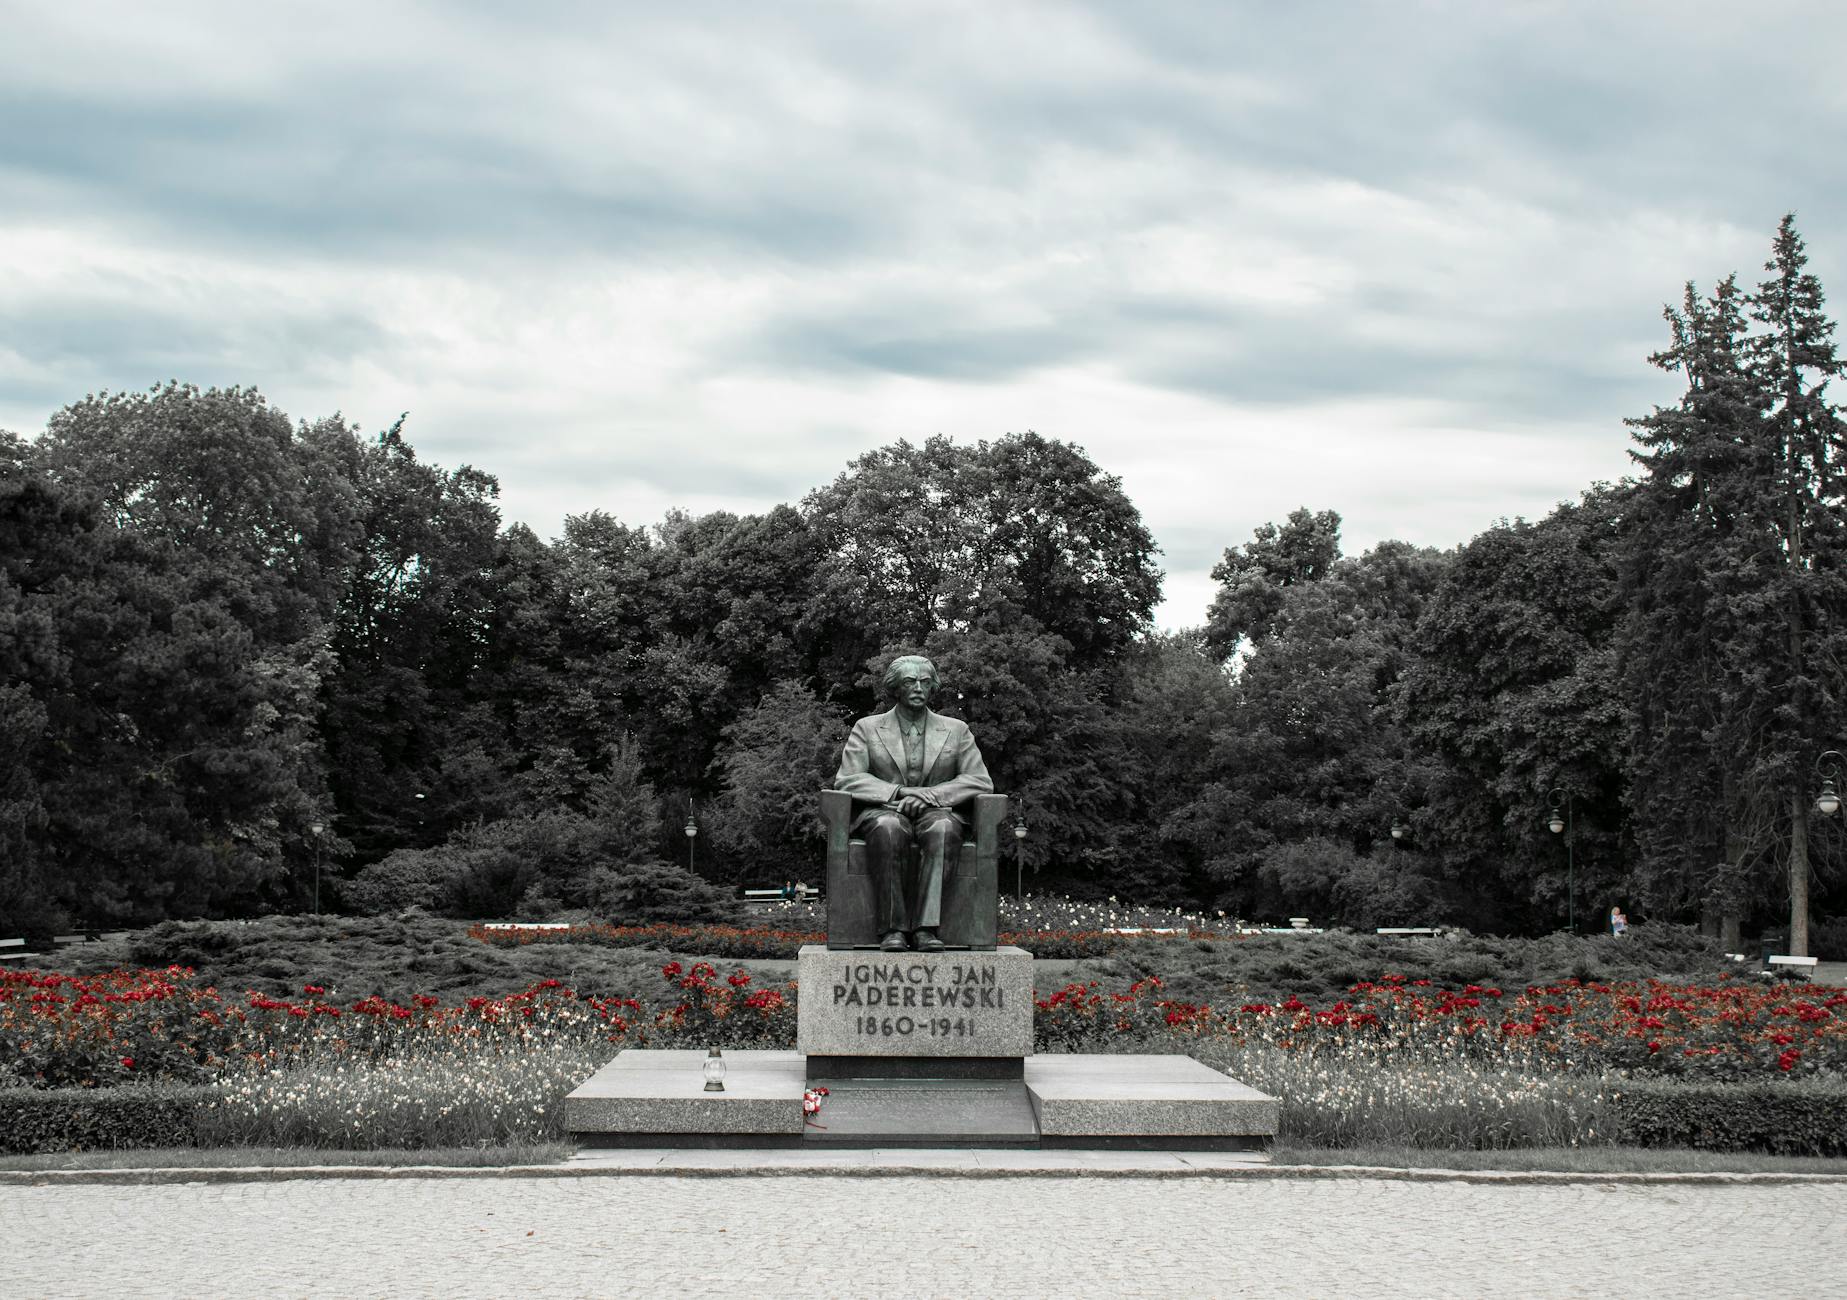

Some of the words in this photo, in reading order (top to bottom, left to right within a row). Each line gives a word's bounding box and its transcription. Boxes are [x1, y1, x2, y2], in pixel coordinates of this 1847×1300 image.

[845, 965, 937, 984] IGNACY
[952, 966, 996, 985] JAN
[833, 985, 1003, 1008] PADEREWSKI
[857, 1016, 975, 1036] 1860-1941
